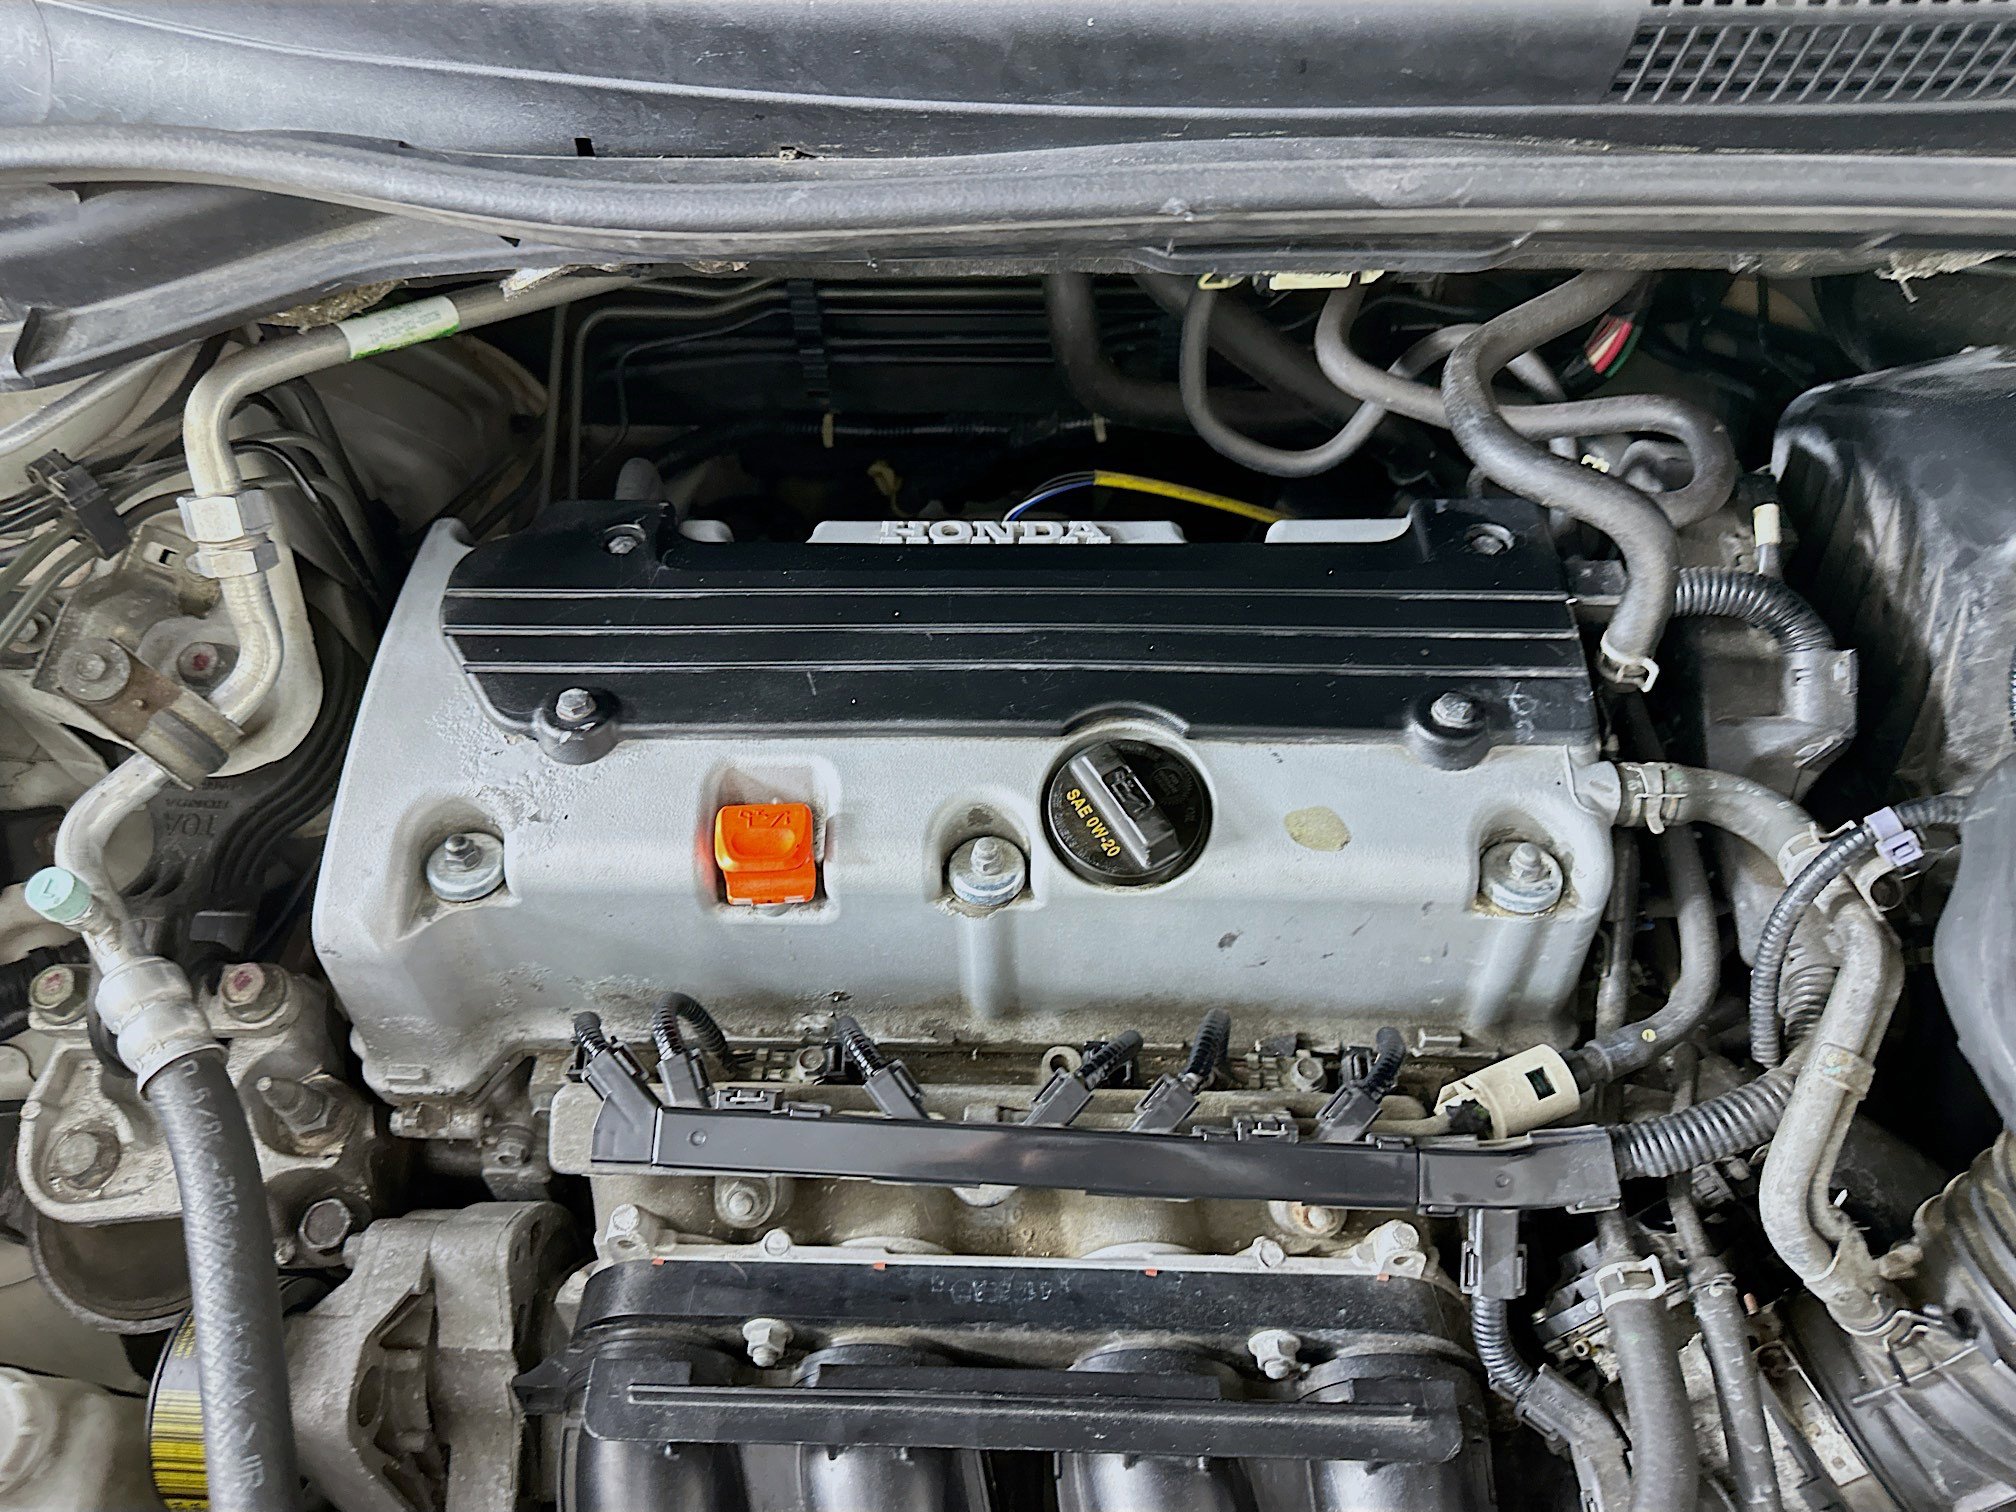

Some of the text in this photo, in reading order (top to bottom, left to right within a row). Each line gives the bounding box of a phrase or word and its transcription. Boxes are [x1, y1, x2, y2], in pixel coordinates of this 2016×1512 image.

[879, 520, 1111, 545] HONDA
[1066, 788, 1094, 819] SAE
[1086, 816, 1121, 857] 0W-20
